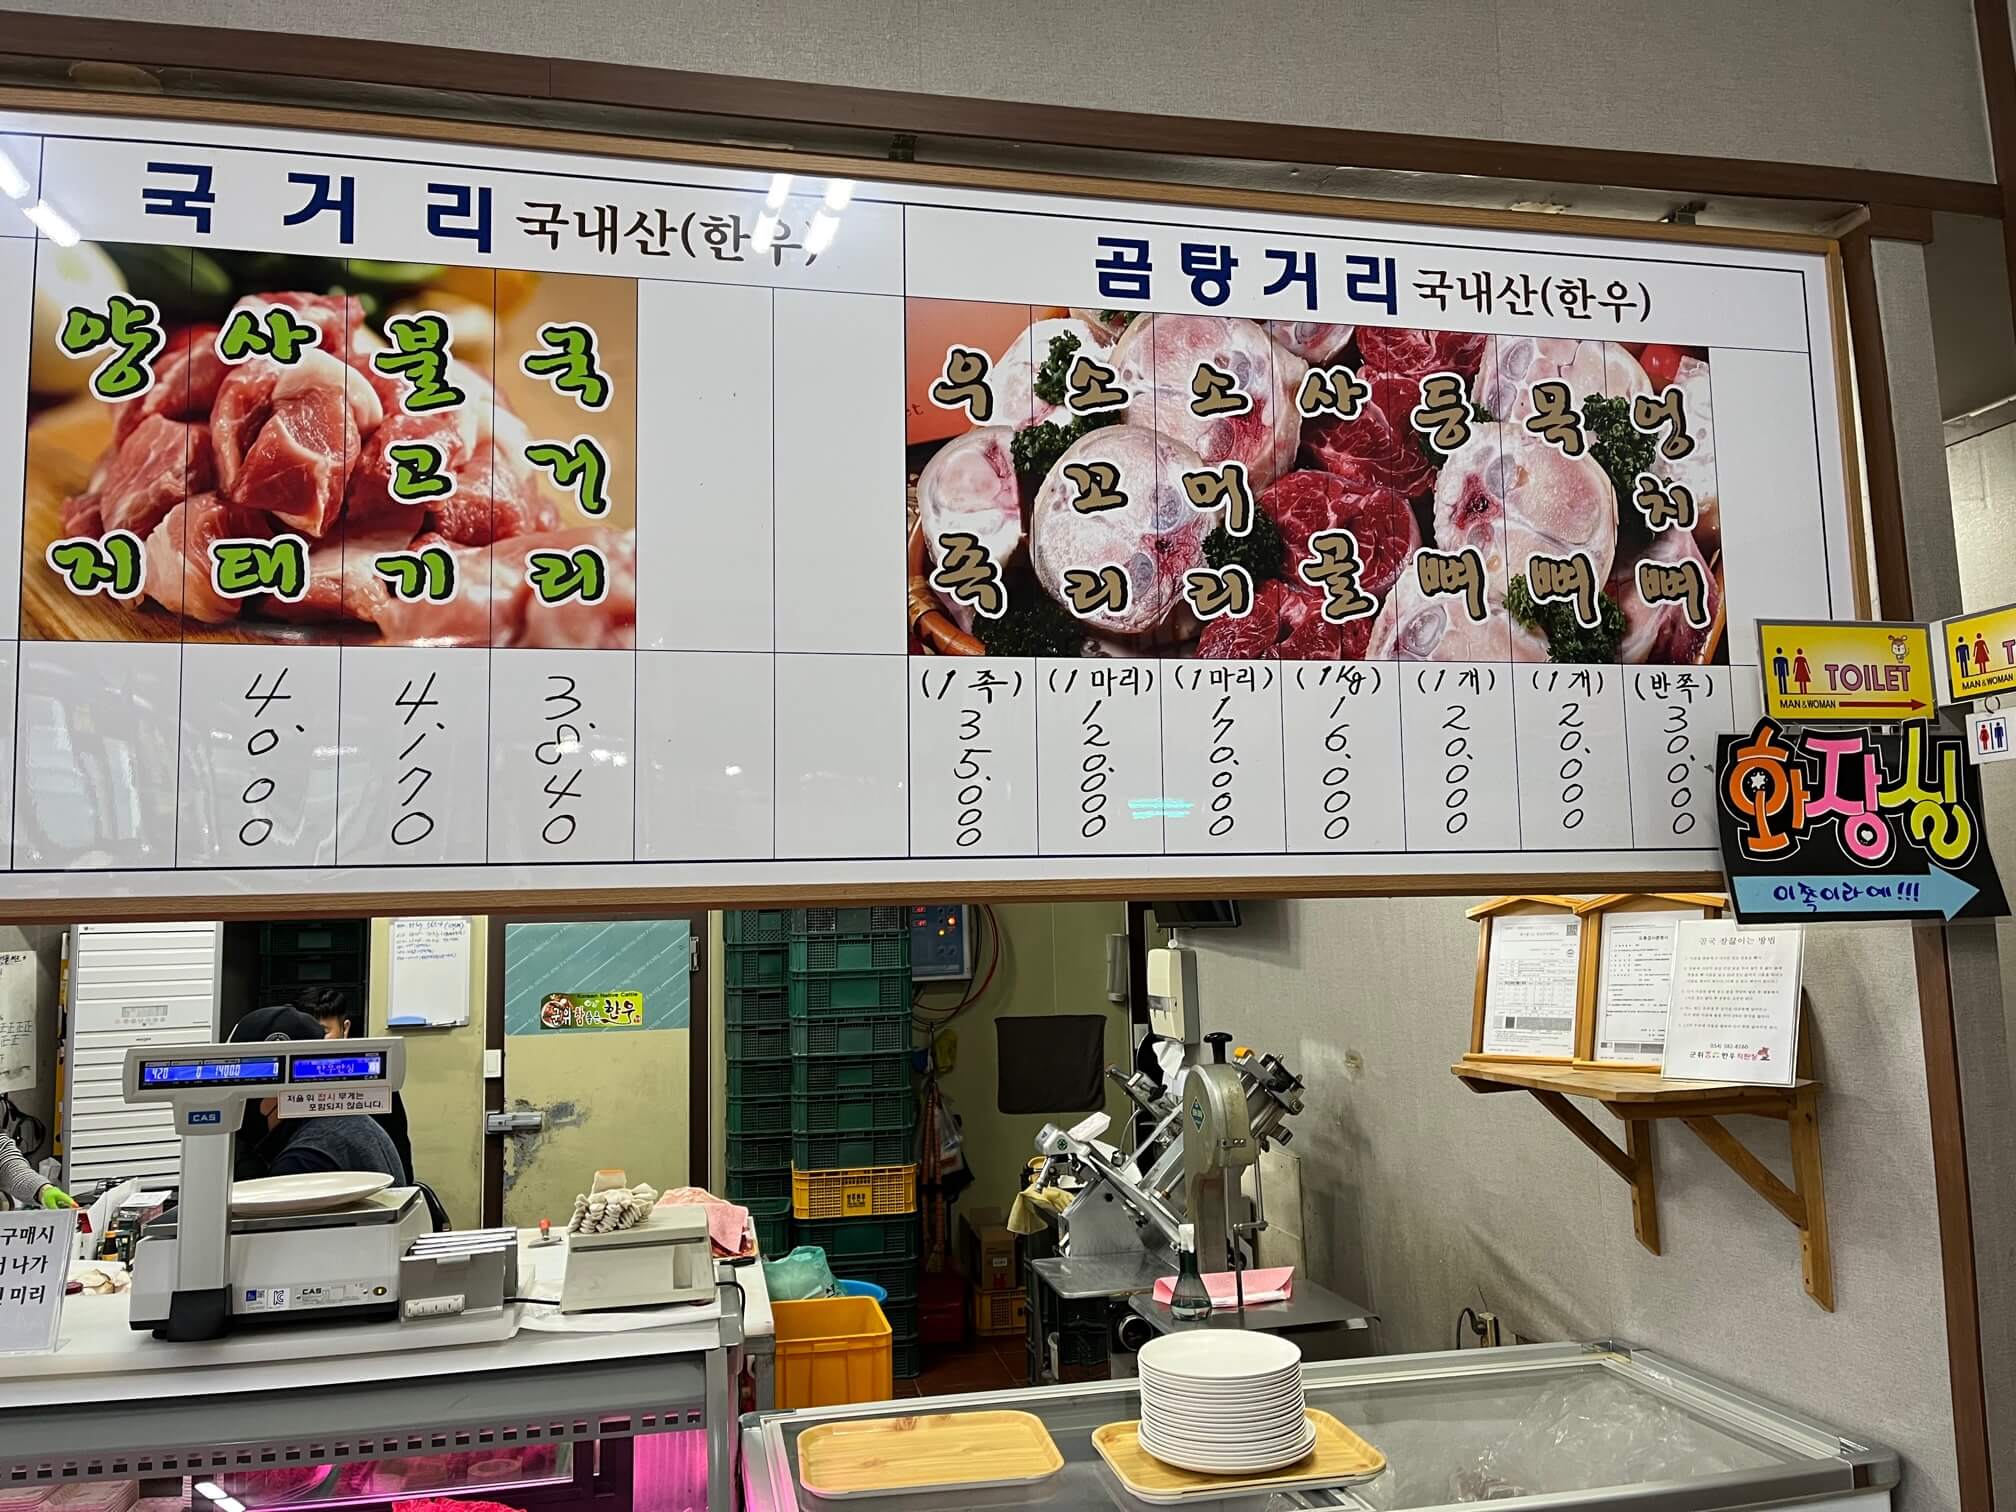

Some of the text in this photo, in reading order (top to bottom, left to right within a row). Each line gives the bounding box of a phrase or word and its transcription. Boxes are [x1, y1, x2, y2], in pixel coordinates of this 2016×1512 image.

[1095, 237, 1399, 315] 곰탕거리
[1414, 267, 1652, 323] 국내산(한우)
[1824, 664, 1910, 692] TOILET
[1962, 679, 1981, 690] MAN
[1986, 673, 2014, 687] WOMAN
[1780, 699, 1801, 709] MAN
[1807, 699, 1836, 709] WOMAN
[1726, 722, 1974, 862] 화장실
[603, 999, 637, 1025] 한우
[192, 1113, 217, 1122] CAS
[0, 1226, 55, 1246] 구매시
[302, 1287, 322, 1296] CAS
